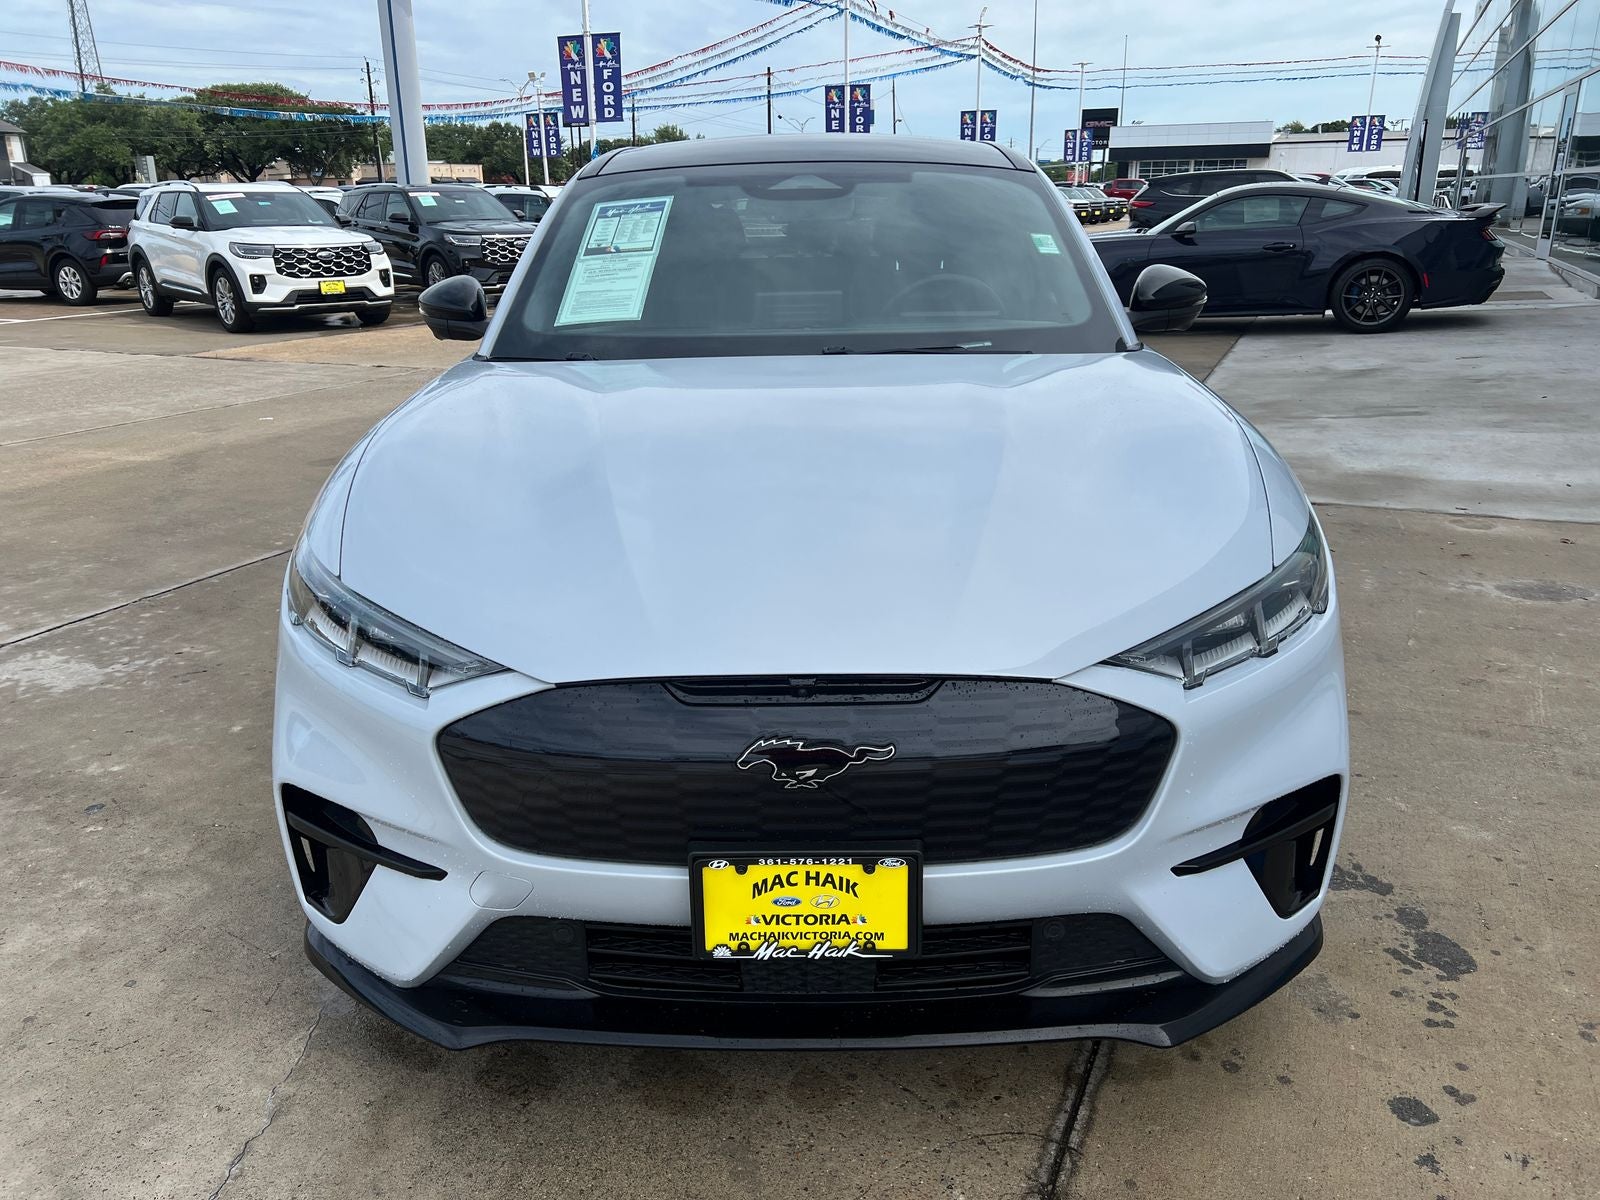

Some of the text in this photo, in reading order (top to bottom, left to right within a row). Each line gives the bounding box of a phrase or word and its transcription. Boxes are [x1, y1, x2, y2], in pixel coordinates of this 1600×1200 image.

[570, 71, 585, 119] NEW
[602, 69, 615, 118] FORD
[831, 108, 840, 130] NE
[856, 108, 864, 132] FOR
[1085, 120, 1114, 128] GMC
[532, 130, 541, 156] NEW
[549, 130, 557, 156] FORD
[1351, 130, 1361, 151] NEW
[1369, 129, 1379, 150] FORD
[1066, 142, 1074, 161] NEW
[758, 858, 853, 866] 361-576-1221
[752, 870, 860, 899] MAC HAIK
[774, 897, 799, 907] Ford
[761, 914, 851, 926] VICTORIA
[729, 931, 884, 942] MACHAIKVICTORIA.COM
[753, 940, 875, 961] Mac Haik
